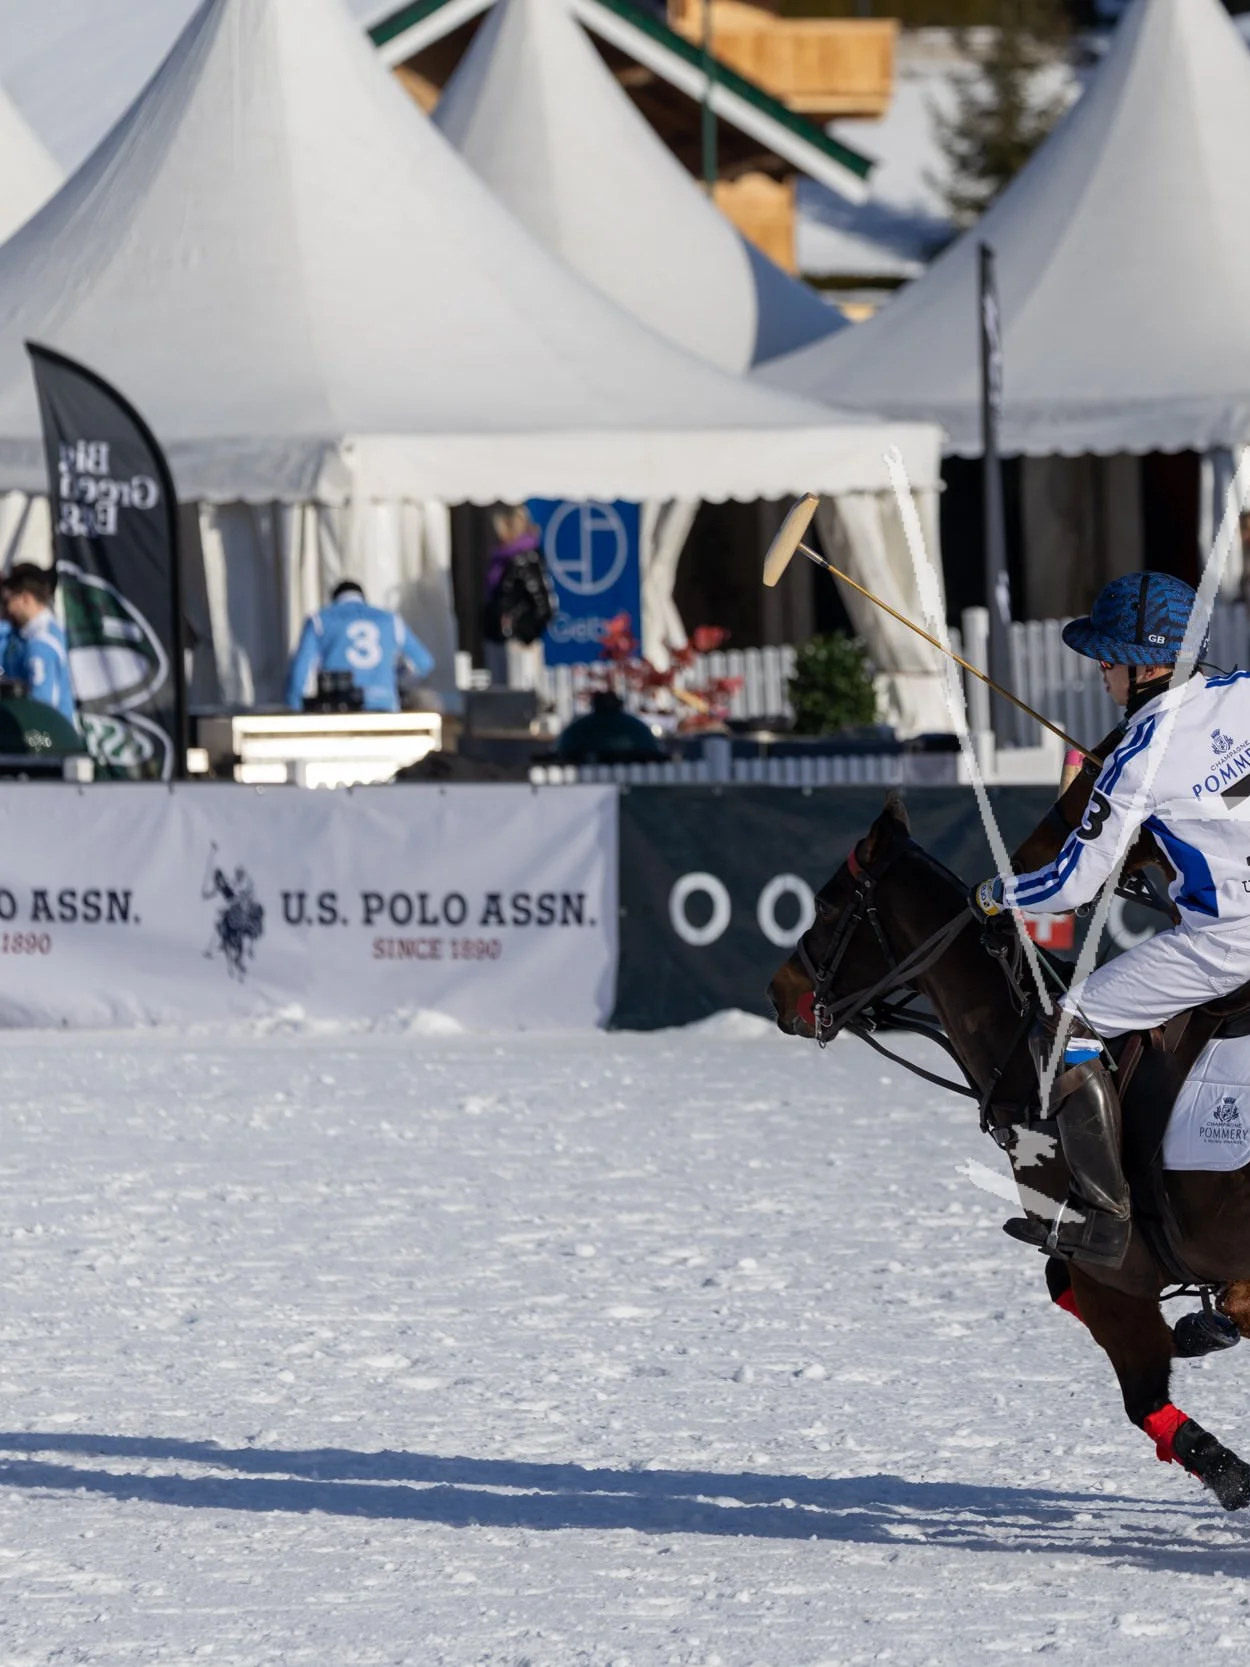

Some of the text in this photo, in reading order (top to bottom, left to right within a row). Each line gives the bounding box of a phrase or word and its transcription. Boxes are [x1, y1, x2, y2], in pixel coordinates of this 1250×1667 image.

[345, 619, 383, 670] 3
[1148, 634, 1165, 644] GB
[1210, 739, 1250, 771] CHAMPAGNE
[1076, 789, 1112, 840] 3
[30, 889, 141, 924] ASSN.
[281, 891, 598, 928] U.S. POLO ASSN.
[2, 932, 53, 955] 1890
[372, 938, 502, 960] SINCE 1890
[1199, 1126, 1249, 1140] POMMERY
